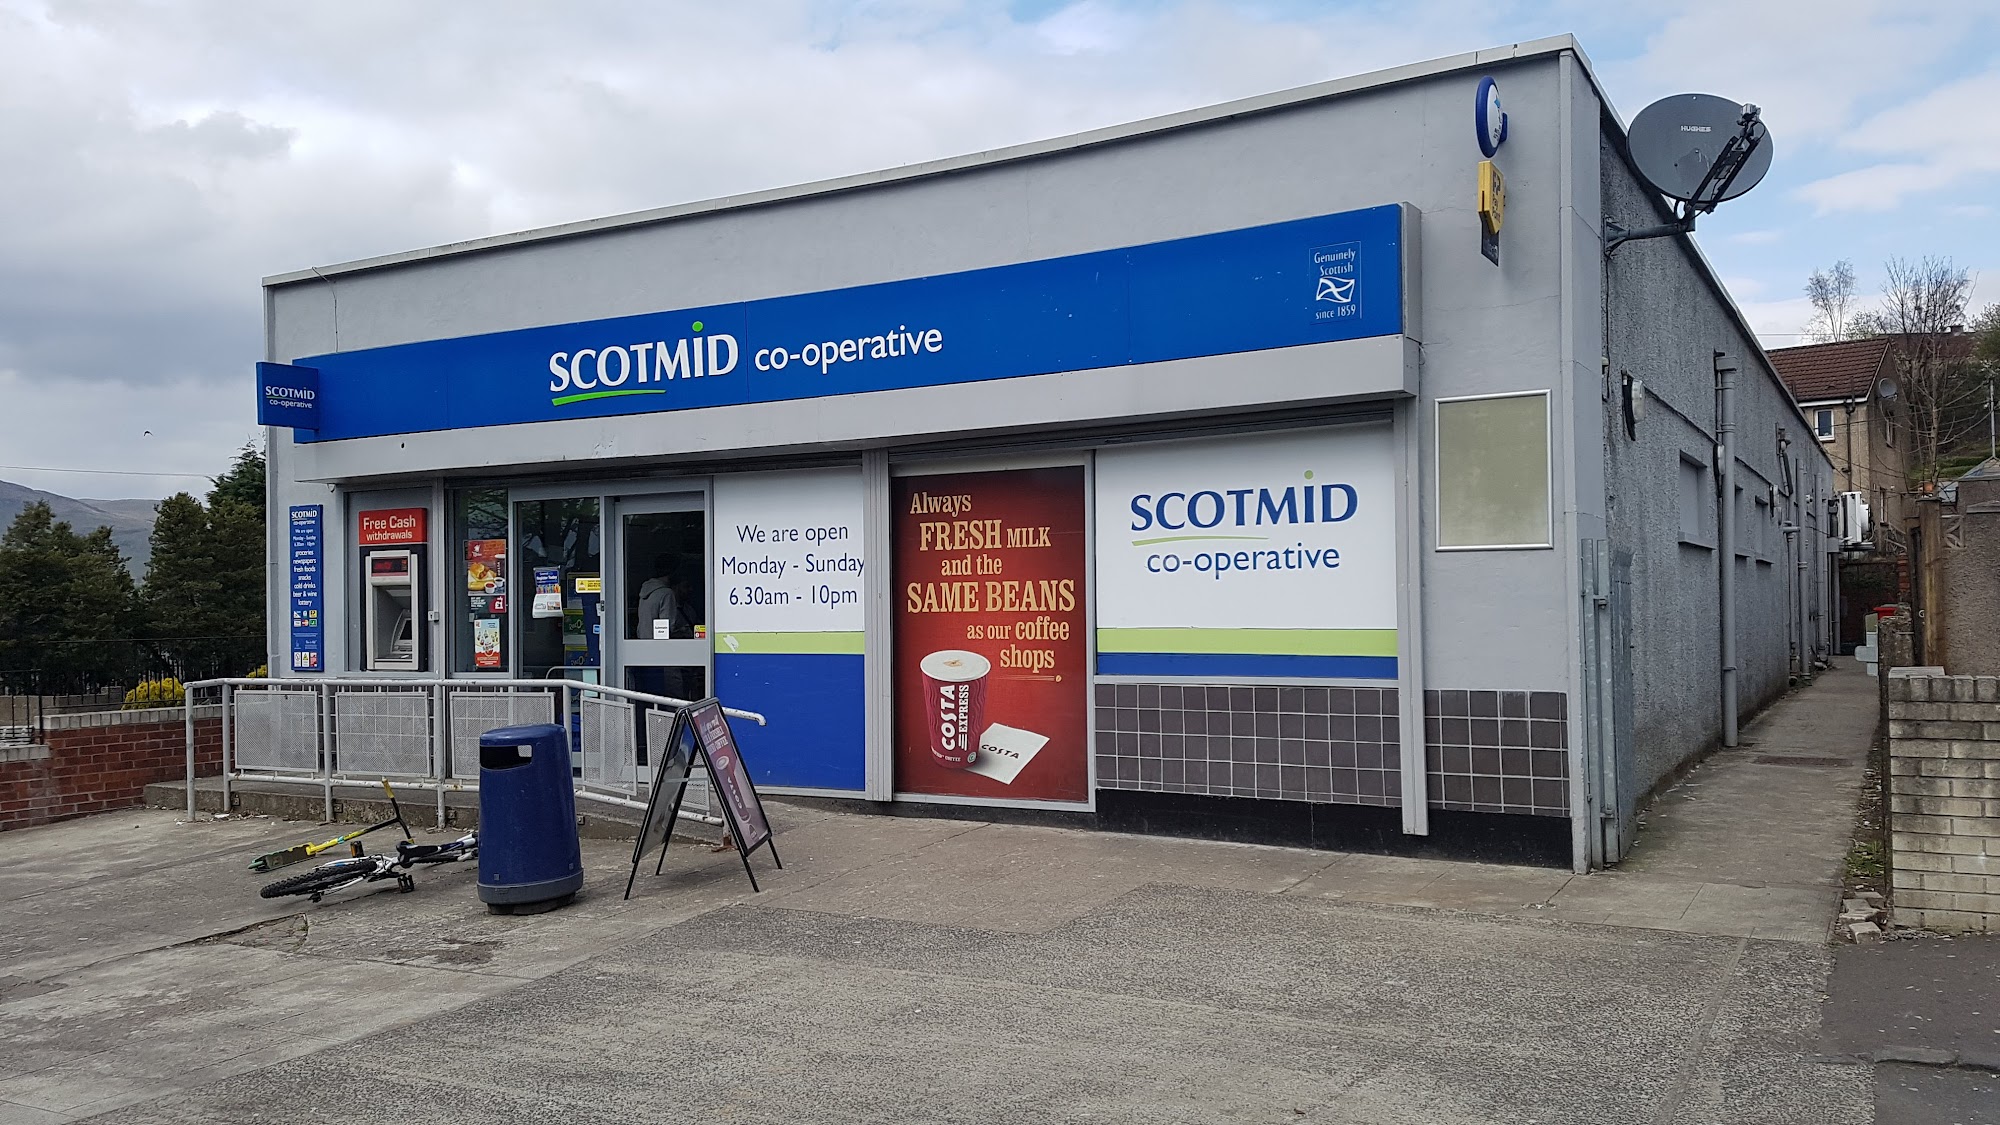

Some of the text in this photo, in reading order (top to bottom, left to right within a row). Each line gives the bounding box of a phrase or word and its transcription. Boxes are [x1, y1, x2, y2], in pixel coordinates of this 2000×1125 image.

[1314, 248, 1356, 264] Genuinely
[1320, 262, 1353, 276] Scottish
[1315, 304, 1356, 320] since 1859
[754, 324, 943, 374] co-operative
[269, 399, 313, 408] co-operative
[910, 492, 972, 517] Always
[363, 514, 416, 531] Free Cash
[366, 529, 413, 541] withdrawals
[736, 524, 848, 546] We are open
[919, 519, 1052, 551] FRESH MILK
[721, 556, 787, 579] Monday
[805, 553, 865, 577] Sunday
[941, 554, 1003, 576] and the
[1147, 542, 1340, 580] co-operative
[729, 586, 789, 606] 6.30am
[812, 585, 857, 610] 10pm
[907, 579, 1076, 613] SAME BEANS
[967, 615, 1070, 641] as our coffee
[1000, 643, 1055, 674] shops
[940, 685, 958, 751] COSTA
[958, 684, 969, 733] EXPRESS
[981, 744, 1020, 760] COSTA
